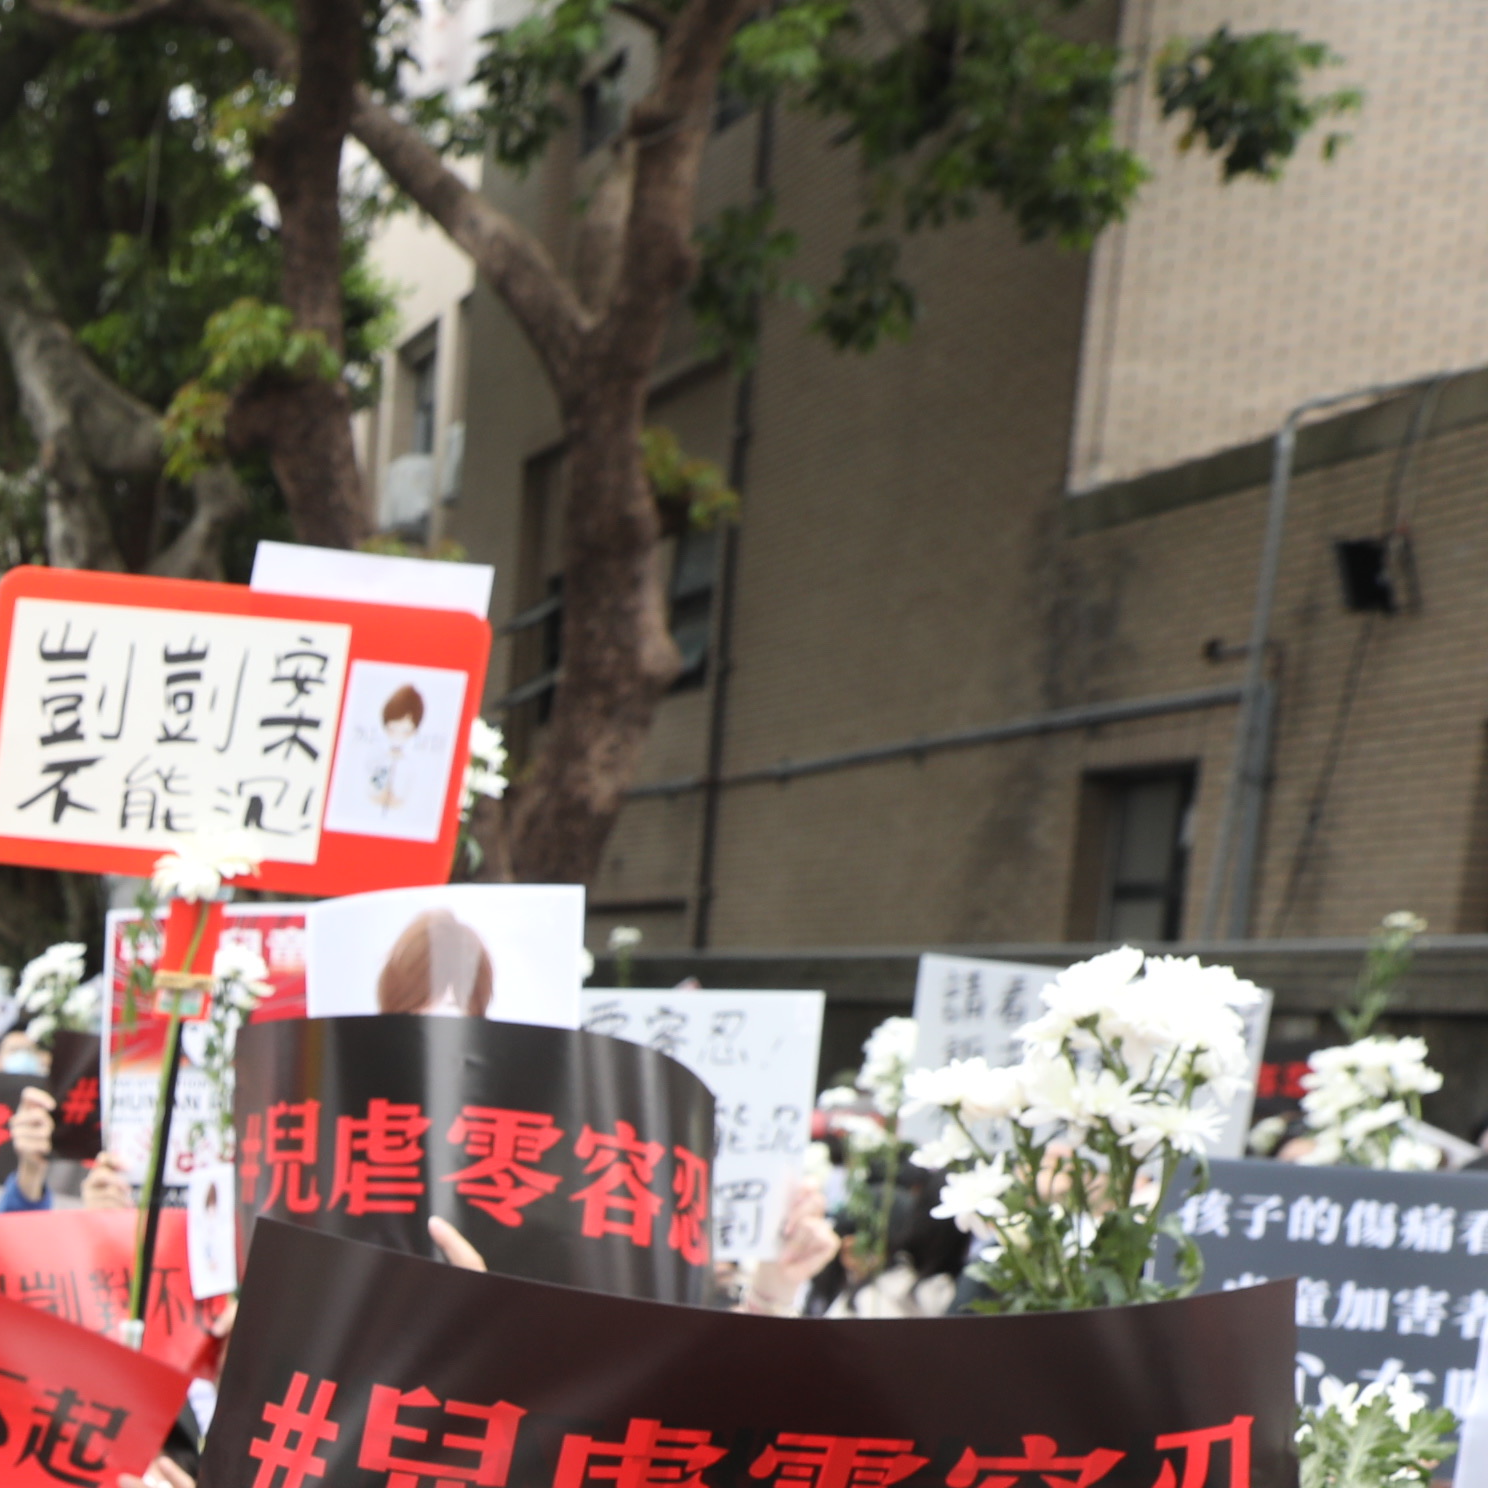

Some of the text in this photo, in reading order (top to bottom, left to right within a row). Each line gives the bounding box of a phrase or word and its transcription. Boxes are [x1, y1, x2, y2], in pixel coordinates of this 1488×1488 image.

[239, 1097, 711, 1268] #兒虐零容忍
[1223, 1270, 1486, 1342] 童加害者
